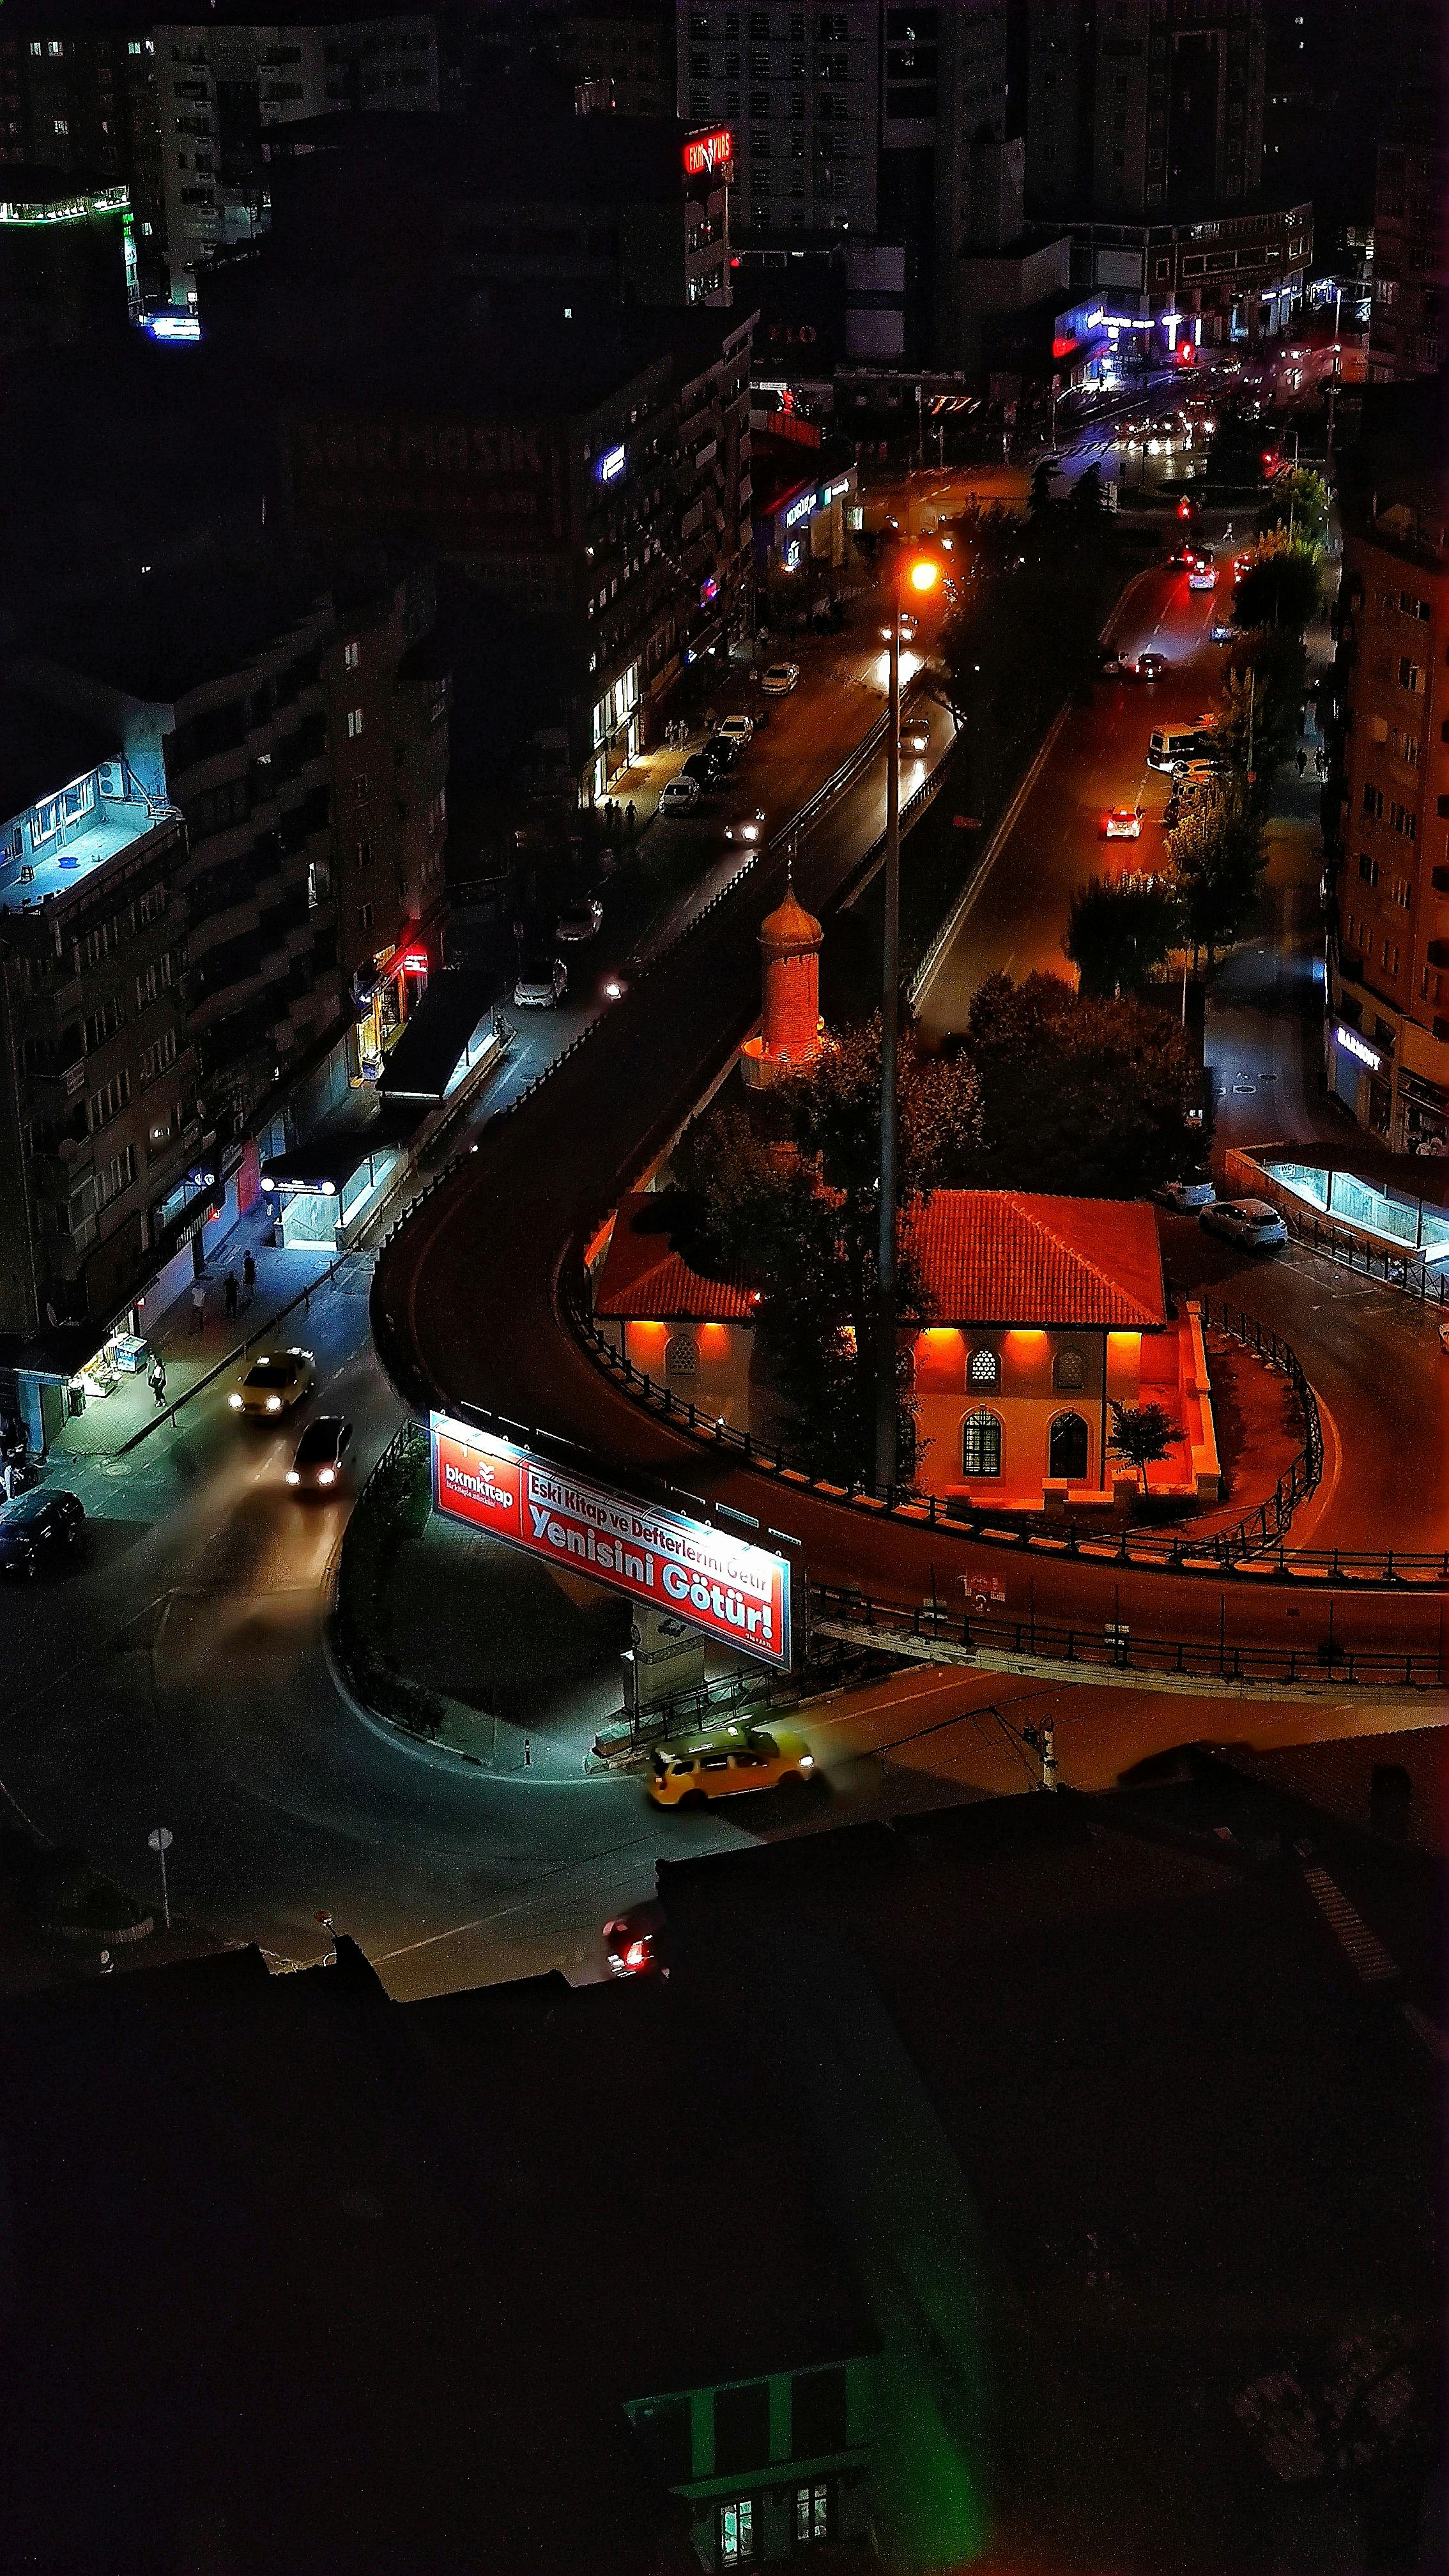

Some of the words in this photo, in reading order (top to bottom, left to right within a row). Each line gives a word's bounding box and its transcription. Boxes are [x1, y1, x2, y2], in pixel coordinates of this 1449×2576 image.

[445, 1463, 513, 1508] bkmkitap
[532, 1475, 561, 1505] Eski
[565, 1489, 608, 1526] Kitap
[609, 1513, 629, 1532] ve
[631, 1517, 722, 1572] Defterlerini
[529, 1503, 654, 1587] Yenisini
[663, 1563, 772, 1639] Götür!
